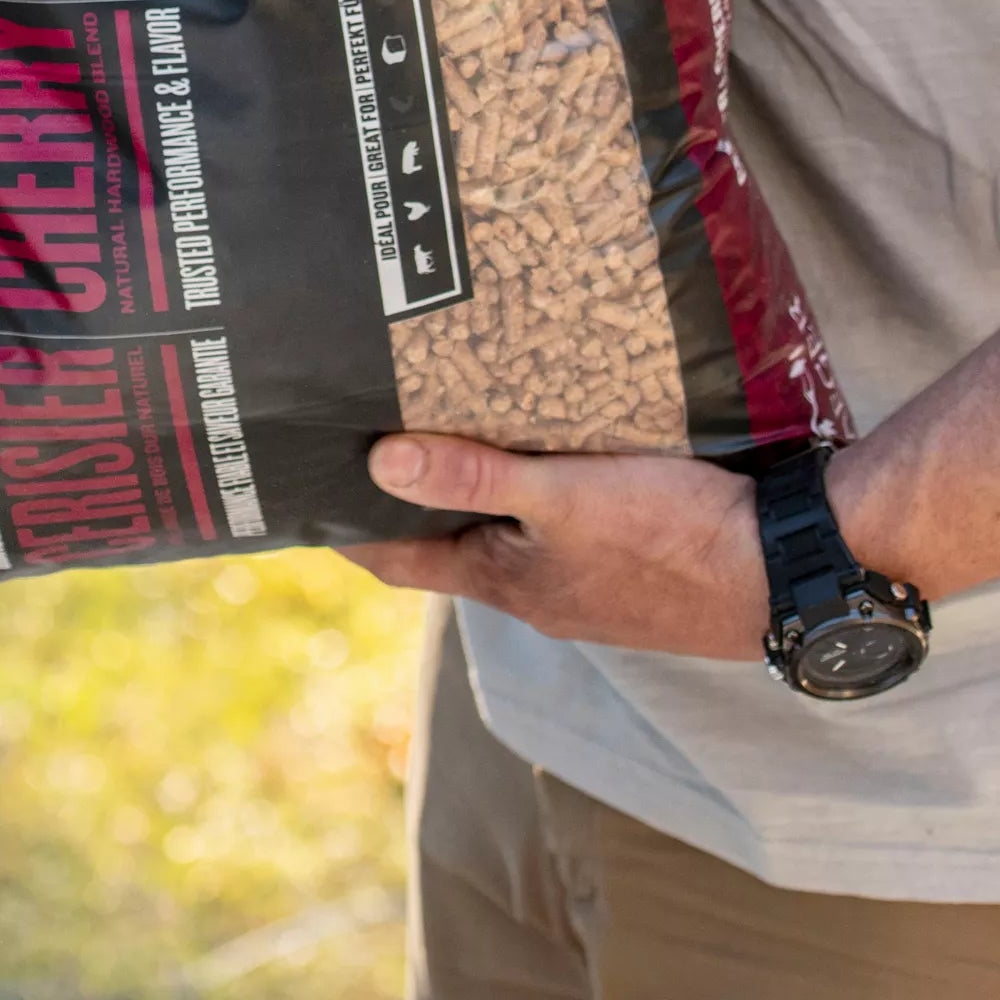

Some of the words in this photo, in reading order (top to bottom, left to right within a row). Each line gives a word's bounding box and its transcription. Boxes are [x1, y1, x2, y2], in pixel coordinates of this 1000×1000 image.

[83, 11, 106, 84] BLEND
[144, 6, 189, 75] FLAVOR
[346, 19, 371, 84] PERFEKT
[153, 77, 191, 97] &
[358, 93, 377, 122] FOR
[94, 89, 124, 213] HARDWOOD
[156, 99, 210, 233] PERFORMANCE
[362, 126, 384, 172] GREAT
[371, 180, 391, 219] POUR
[111, 219, 136, 314] NATURAL
[175, 234, 221, 311] TRUSTED
[373, 221, 397, 261] IDÉAL
[127, 344, 152, 420] NATUREL
[190, 335, 236, 399] GARANTIE
[140, 423, 160, 453] DUR
[201, 396, 244, 442] SAVEUR
